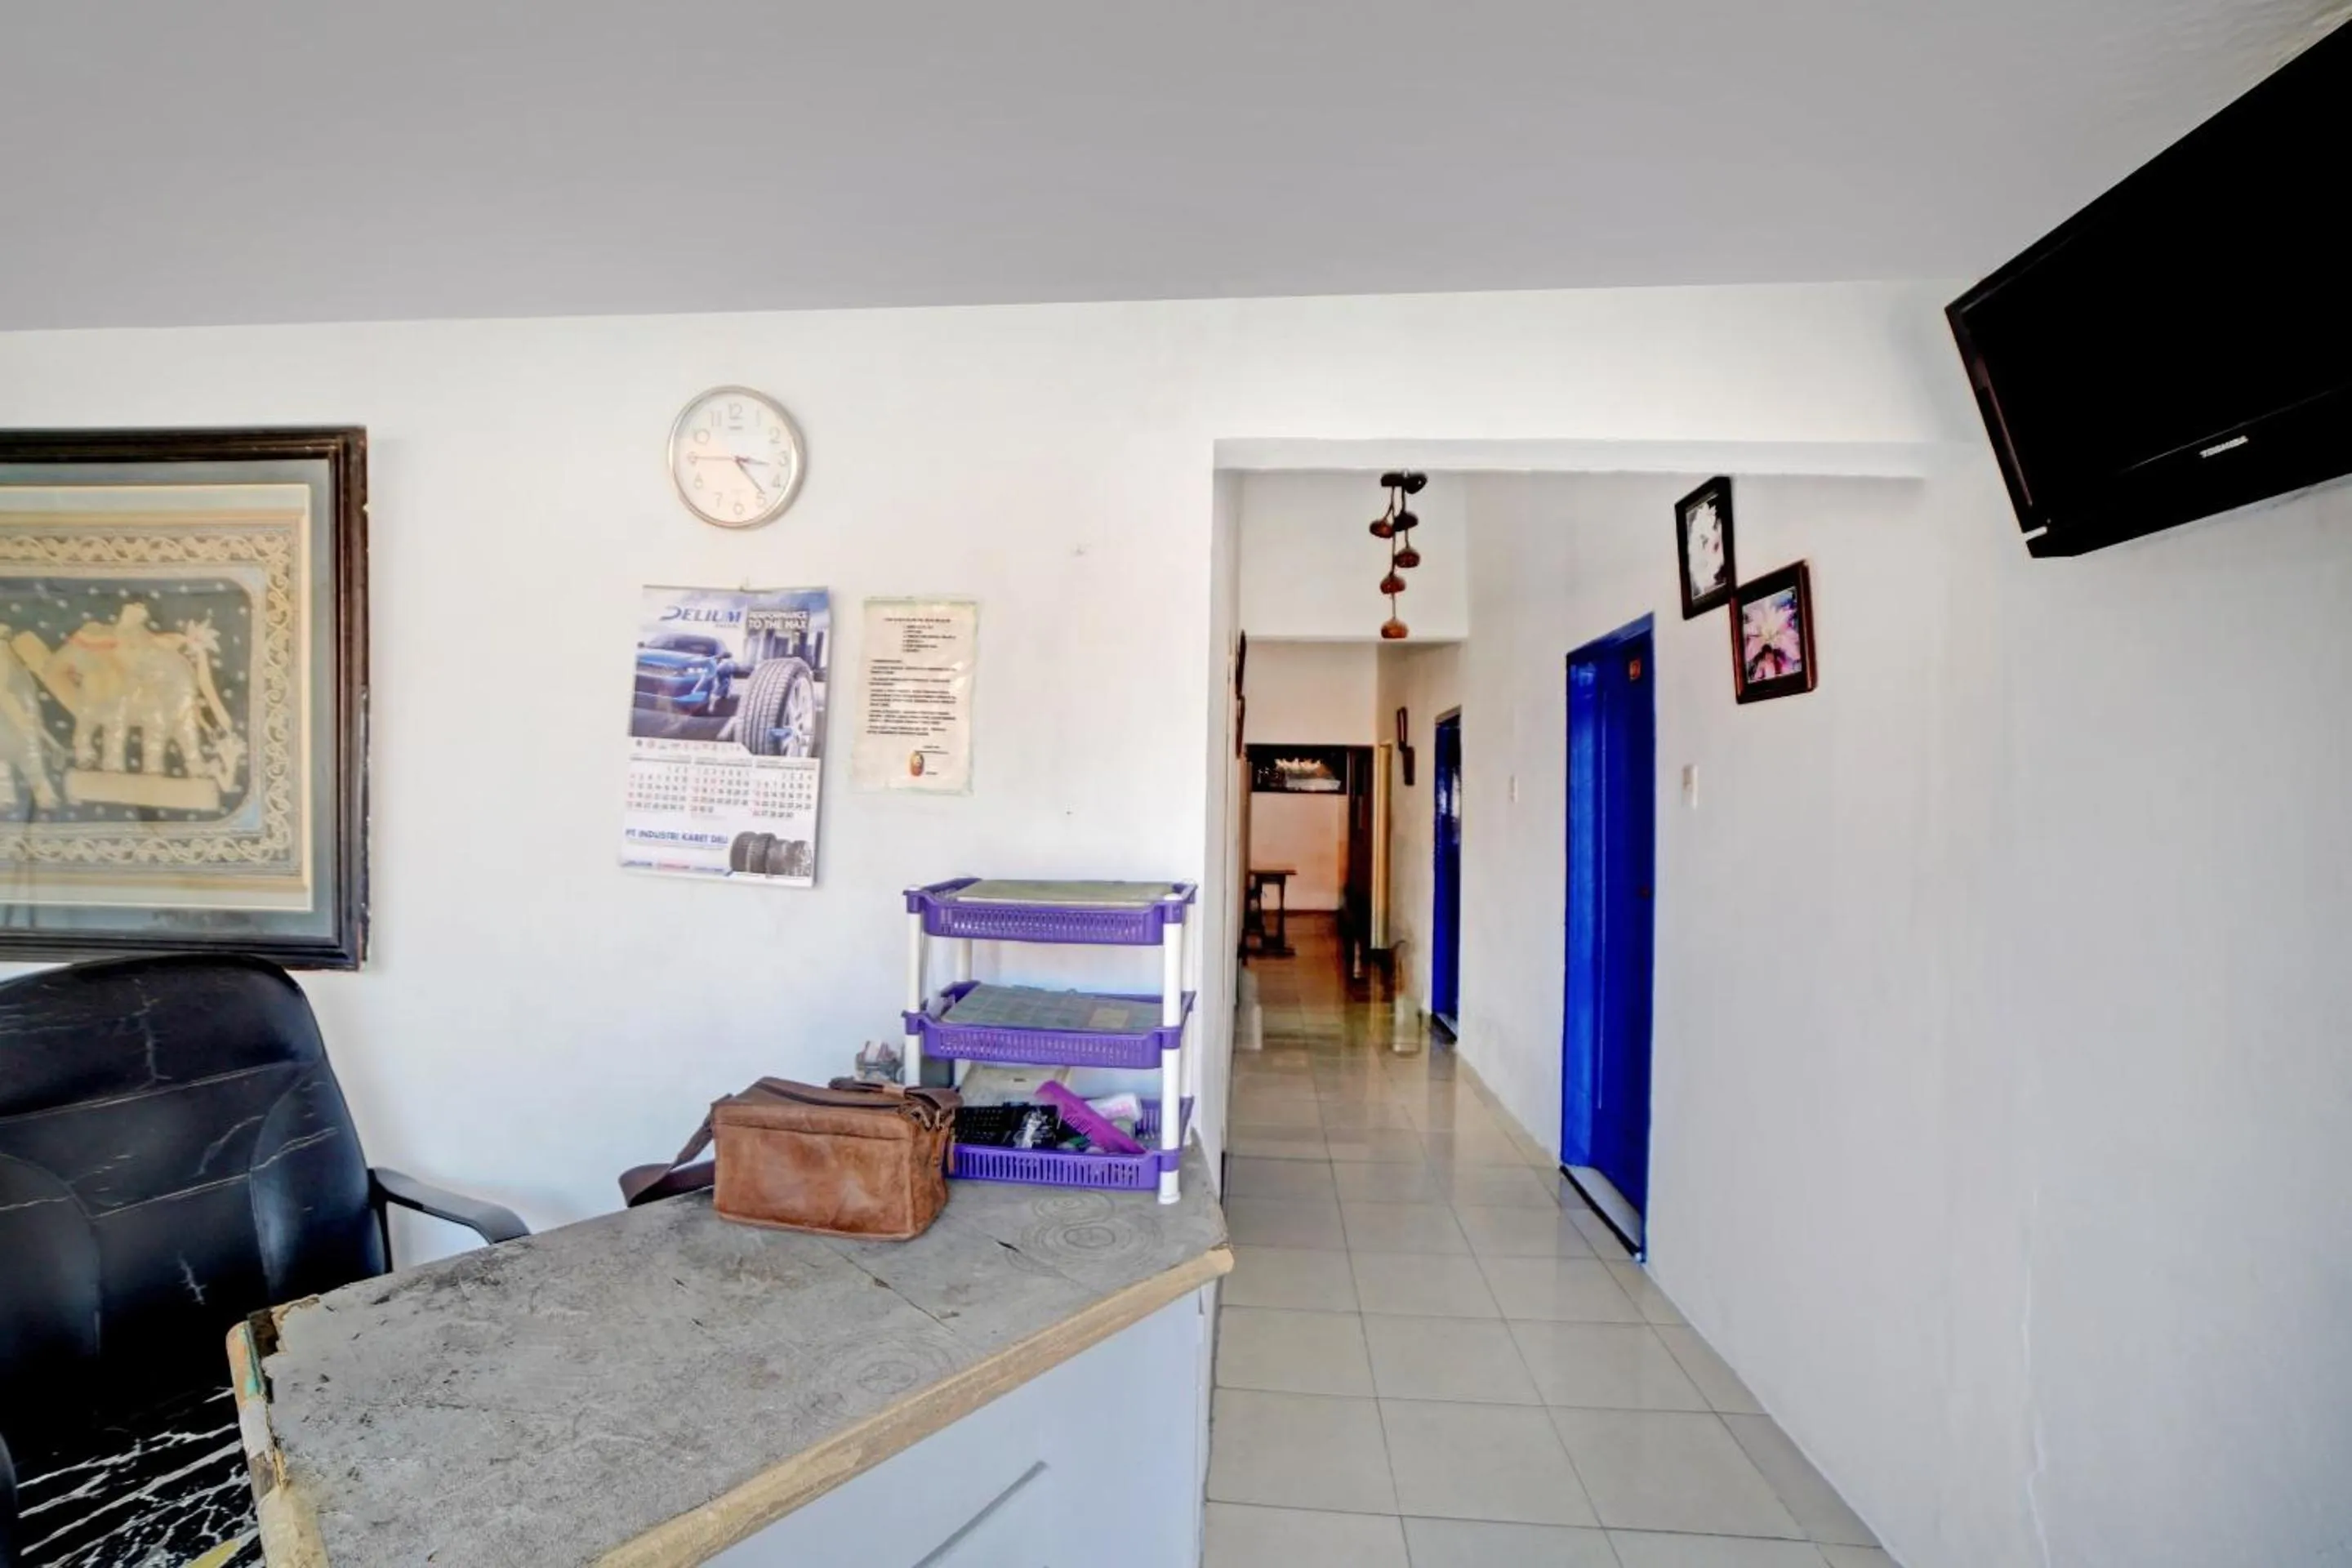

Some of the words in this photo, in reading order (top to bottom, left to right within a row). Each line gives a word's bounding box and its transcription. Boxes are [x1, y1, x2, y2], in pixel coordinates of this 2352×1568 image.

[710, 409, 723, 427] 11
[728, 403, 742, 420] 12
[768, 426, 781, 444] 2
[777, 450, 788, 467] 3
[772, 473, 782, 488] 4
[714, 492, 724, 508] 7
[756, 492, 767, 508] 5
[659, 605, 742, 623] DELIUM
[748, 618, 763, 630] TO
[784, 618, 807, 630] MAX
